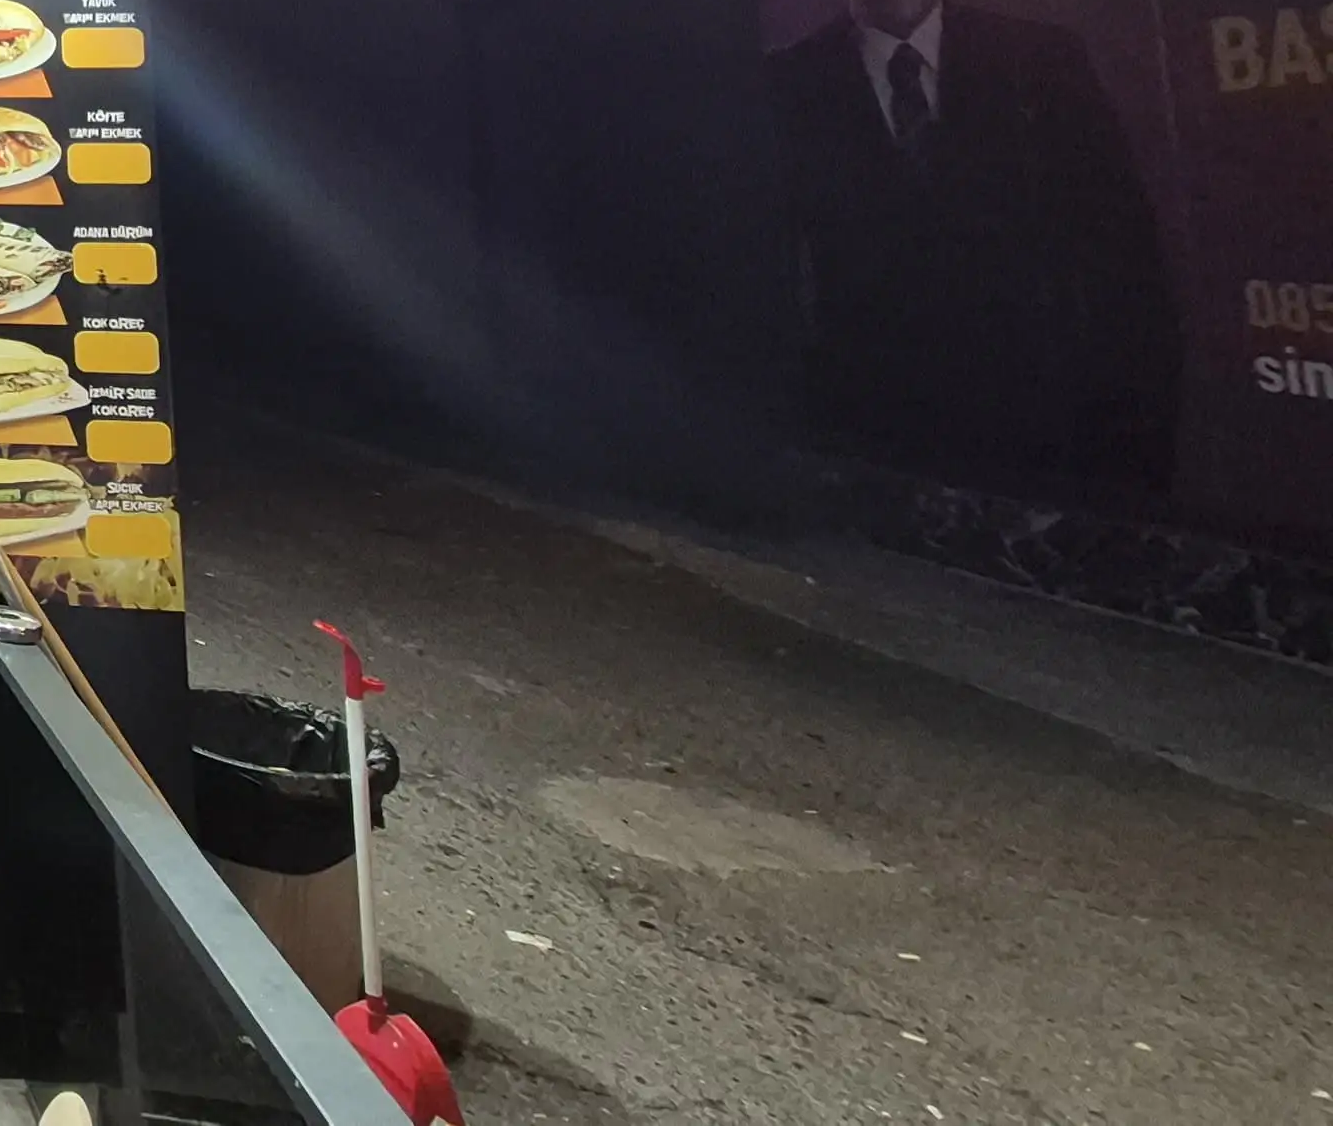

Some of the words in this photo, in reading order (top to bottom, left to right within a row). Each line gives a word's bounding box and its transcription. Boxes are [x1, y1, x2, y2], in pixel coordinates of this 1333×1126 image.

[95, 12, 136, 24] EKMEK
[101, 127, 142, 139] EKMEK
[73, 226, 109, 238] ADANA
[82, 316, 145, 330] KOKOREÇ
[92, 404, 155, 419] KOKOREÇ
